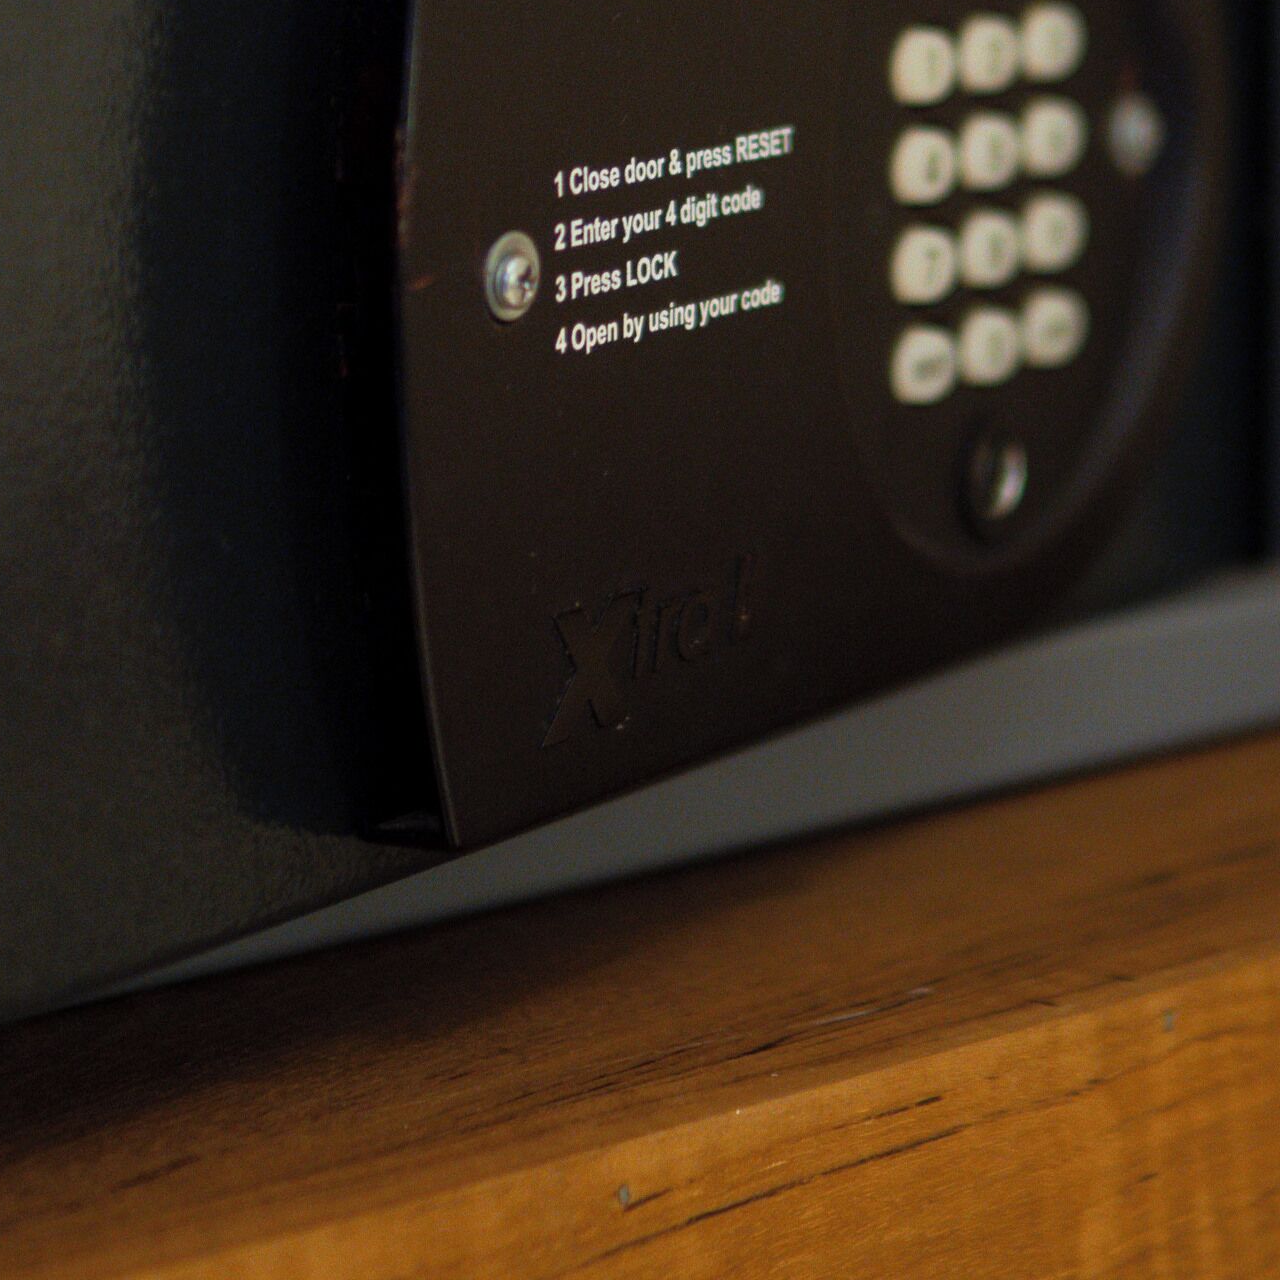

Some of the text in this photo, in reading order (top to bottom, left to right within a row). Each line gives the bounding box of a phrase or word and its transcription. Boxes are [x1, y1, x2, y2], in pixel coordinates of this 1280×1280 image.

[554, 126, 794, 197] 1 Close door & press RESET
[554, 185, 764, 251] 2 Enter your 4 digit code
[555, 251, 677, 302] 3 Press LOCK
[555, 280, 783, 354] 4 Open by using your code
